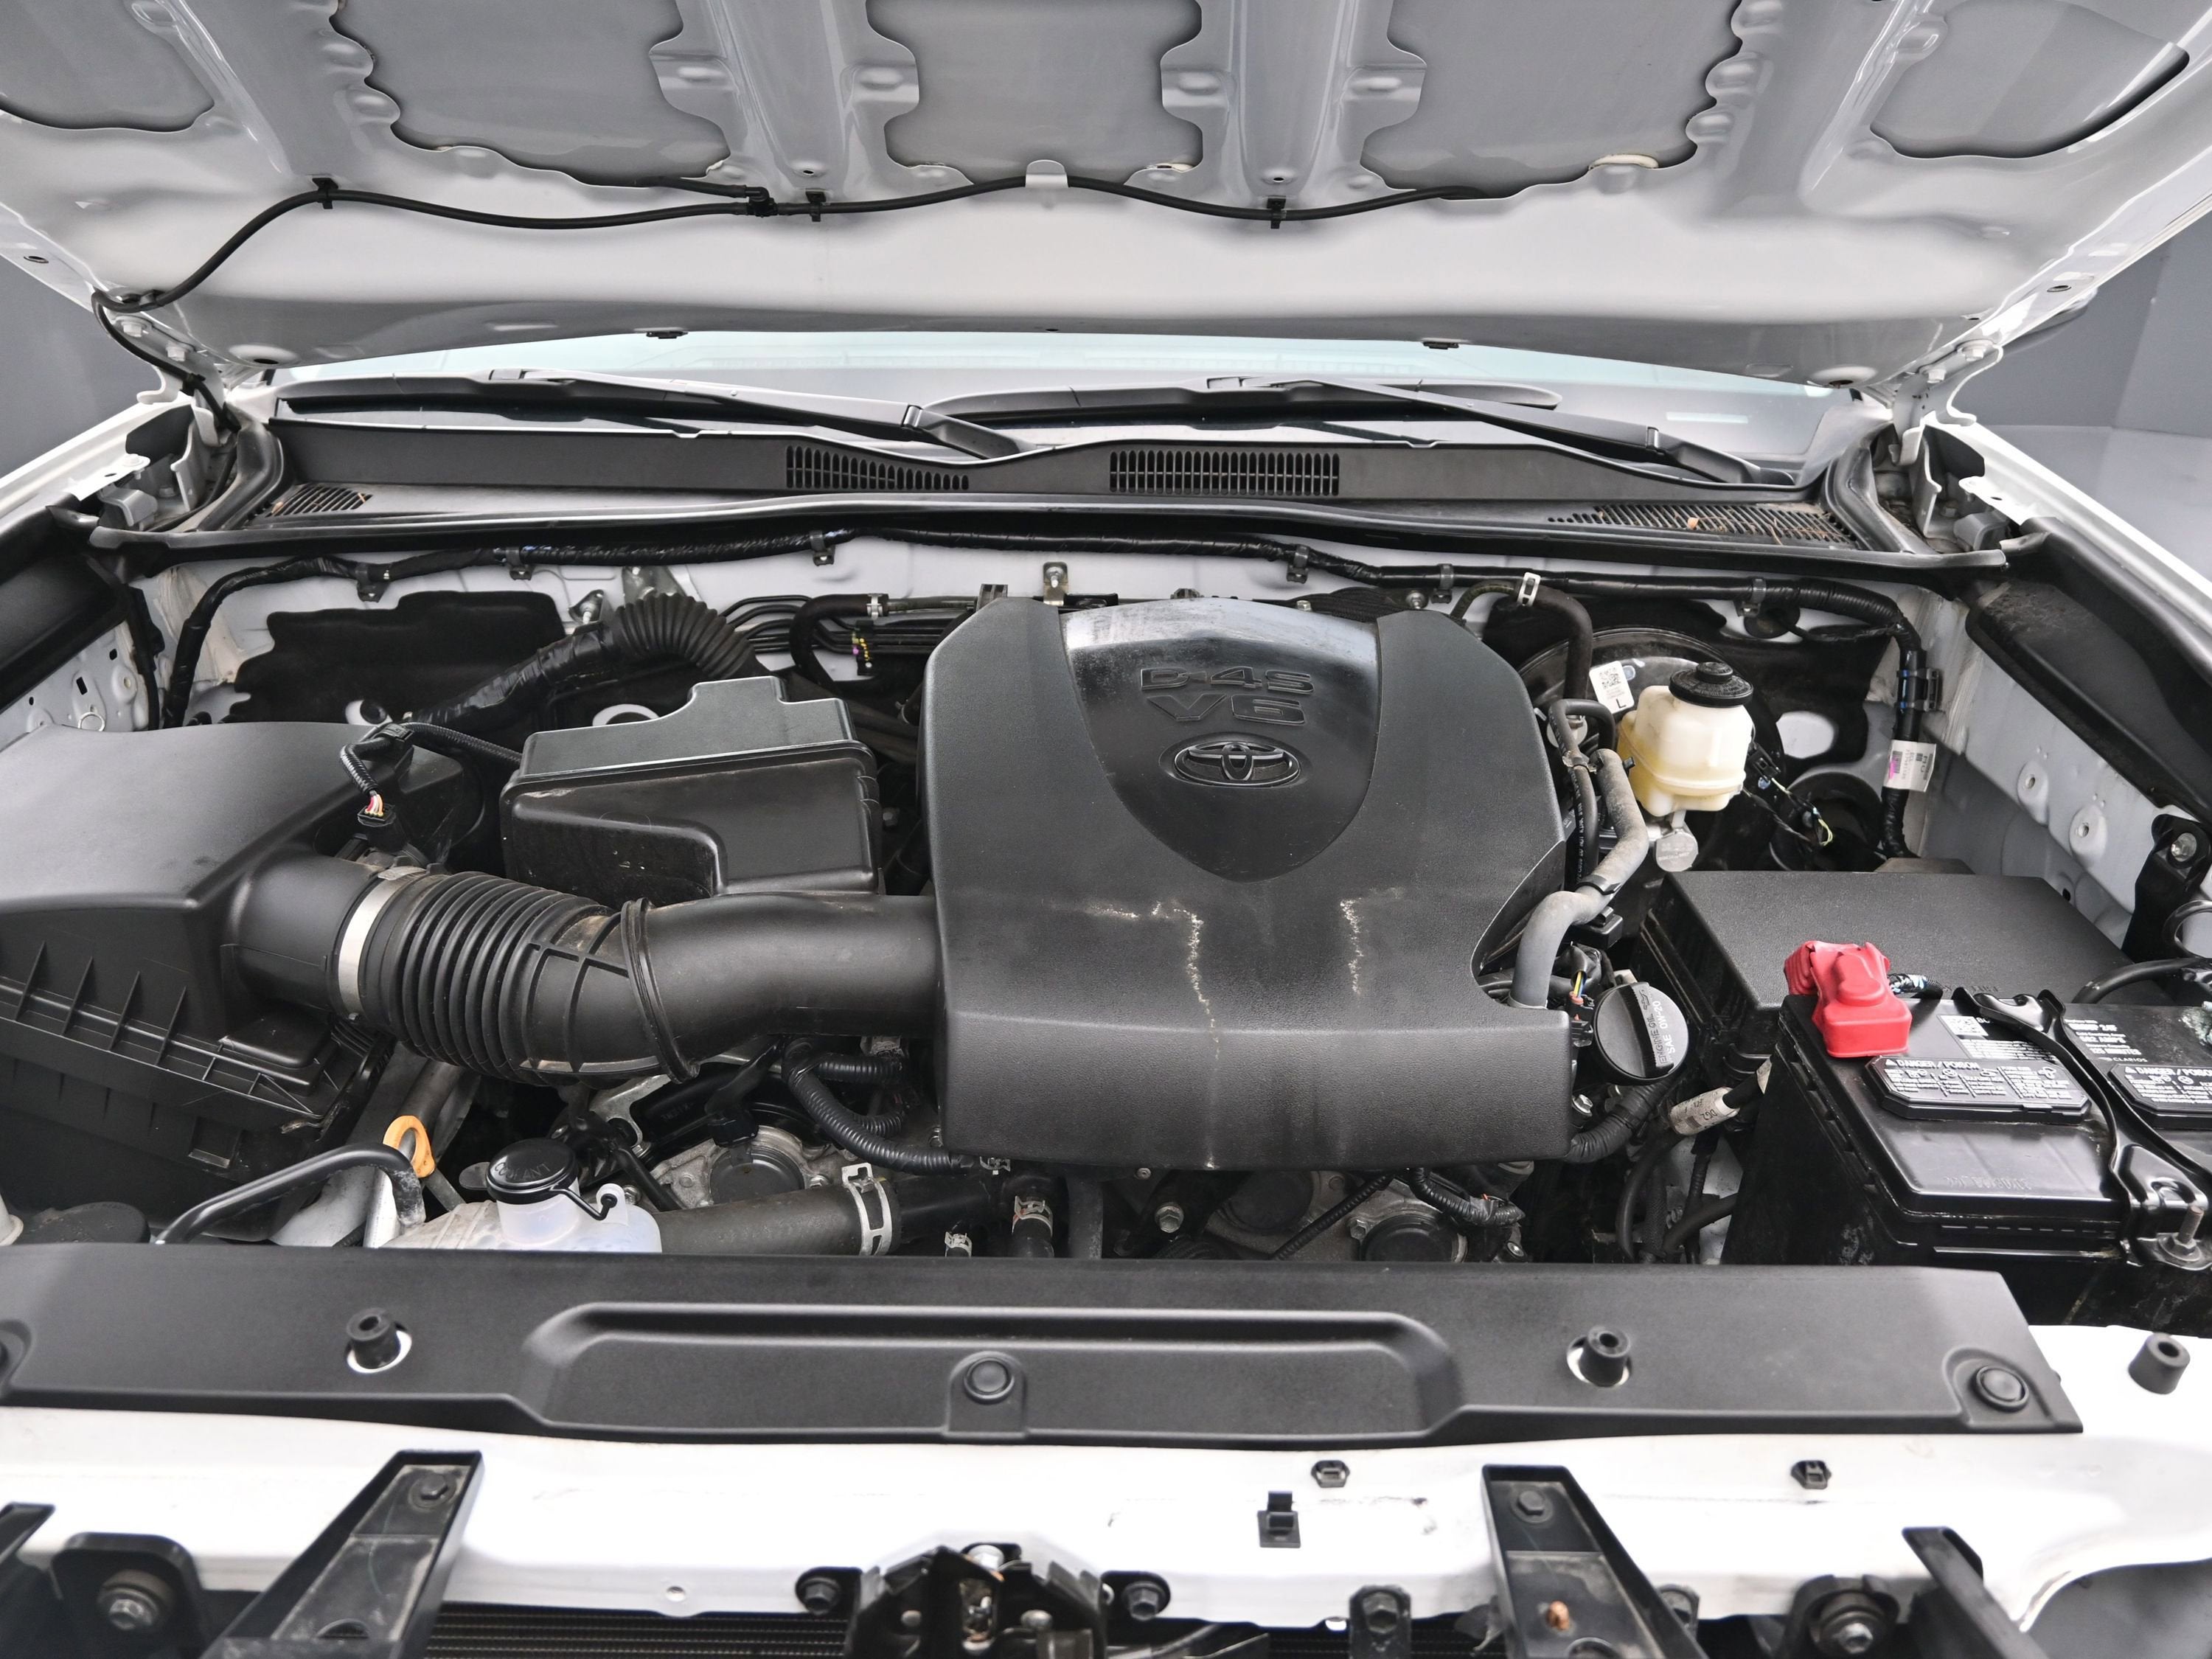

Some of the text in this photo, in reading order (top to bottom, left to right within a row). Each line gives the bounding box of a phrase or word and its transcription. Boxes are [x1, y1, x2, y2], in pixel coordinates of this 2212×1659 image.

[1141, 666, 1315, 695] D-4S
[1147, 693, 1305, 726] V6
[1646, 1013, 1667, 1064] ENGINE OIL
[1652, 1001, 1675, 1054] SAE 0W-20
[495, 1162, 551, 1180] COOLANT
